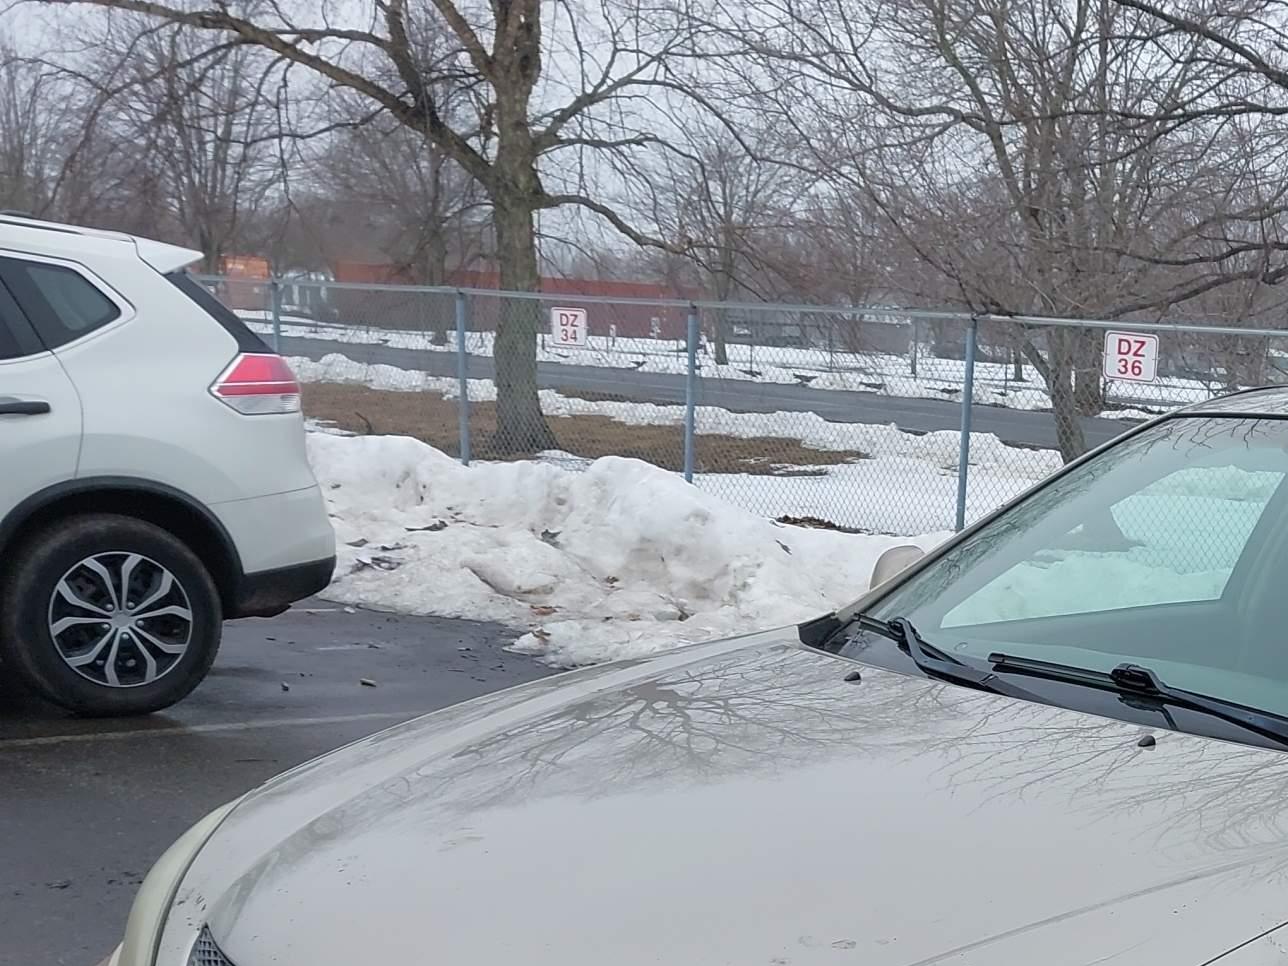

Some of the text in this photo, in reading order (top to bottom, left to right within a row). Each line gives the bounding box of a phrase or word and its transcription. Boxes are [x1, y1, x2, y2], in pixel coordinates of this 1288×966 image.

[560, 313, 579, 327] DZ
[561, 328, 577, 342] 34
[1117, 338, 1146, 357] DZ
[1117, 358, 1142, 376] 36
